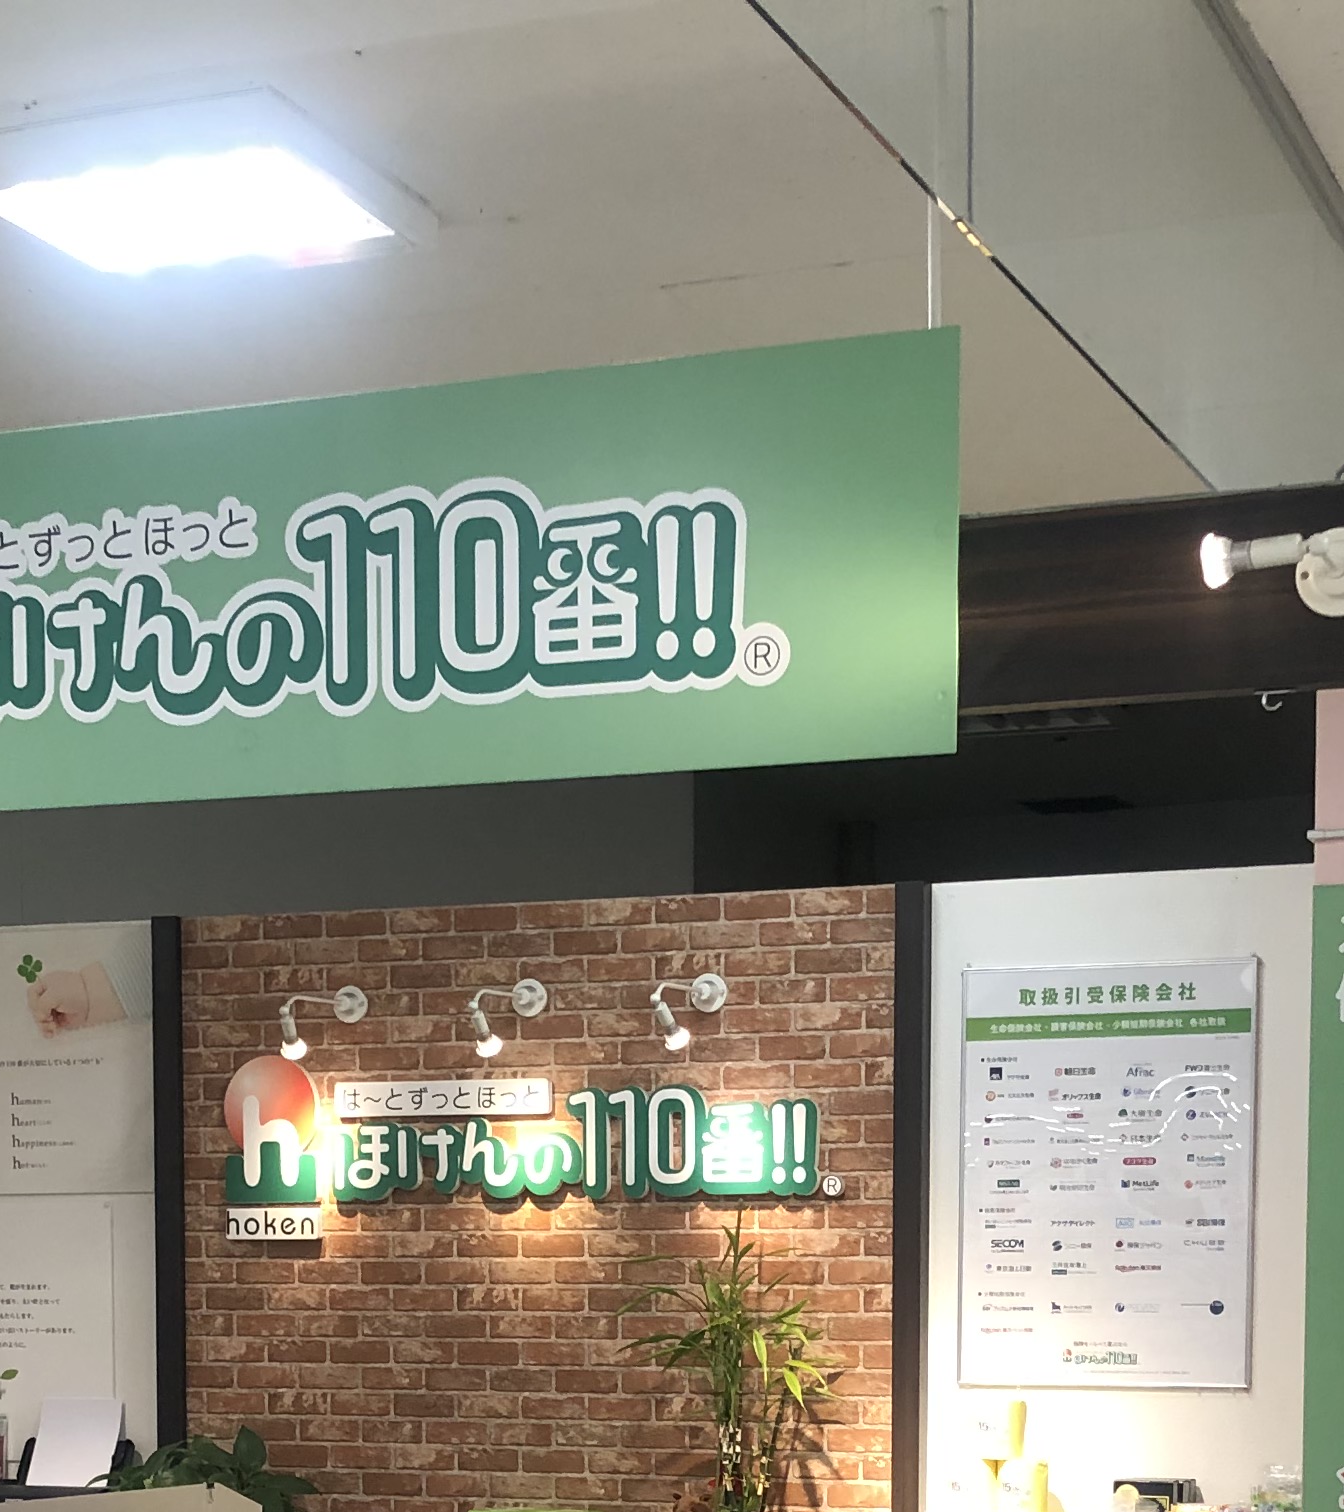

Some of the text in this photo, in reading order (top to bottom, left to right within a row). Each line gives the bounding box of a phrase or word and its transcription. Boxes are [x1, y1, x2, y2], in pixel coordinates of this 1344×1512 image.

[1018, 981, 1198, 1007] 取扱引受保険会社
[225, 1210, 315, 1237] hoken
